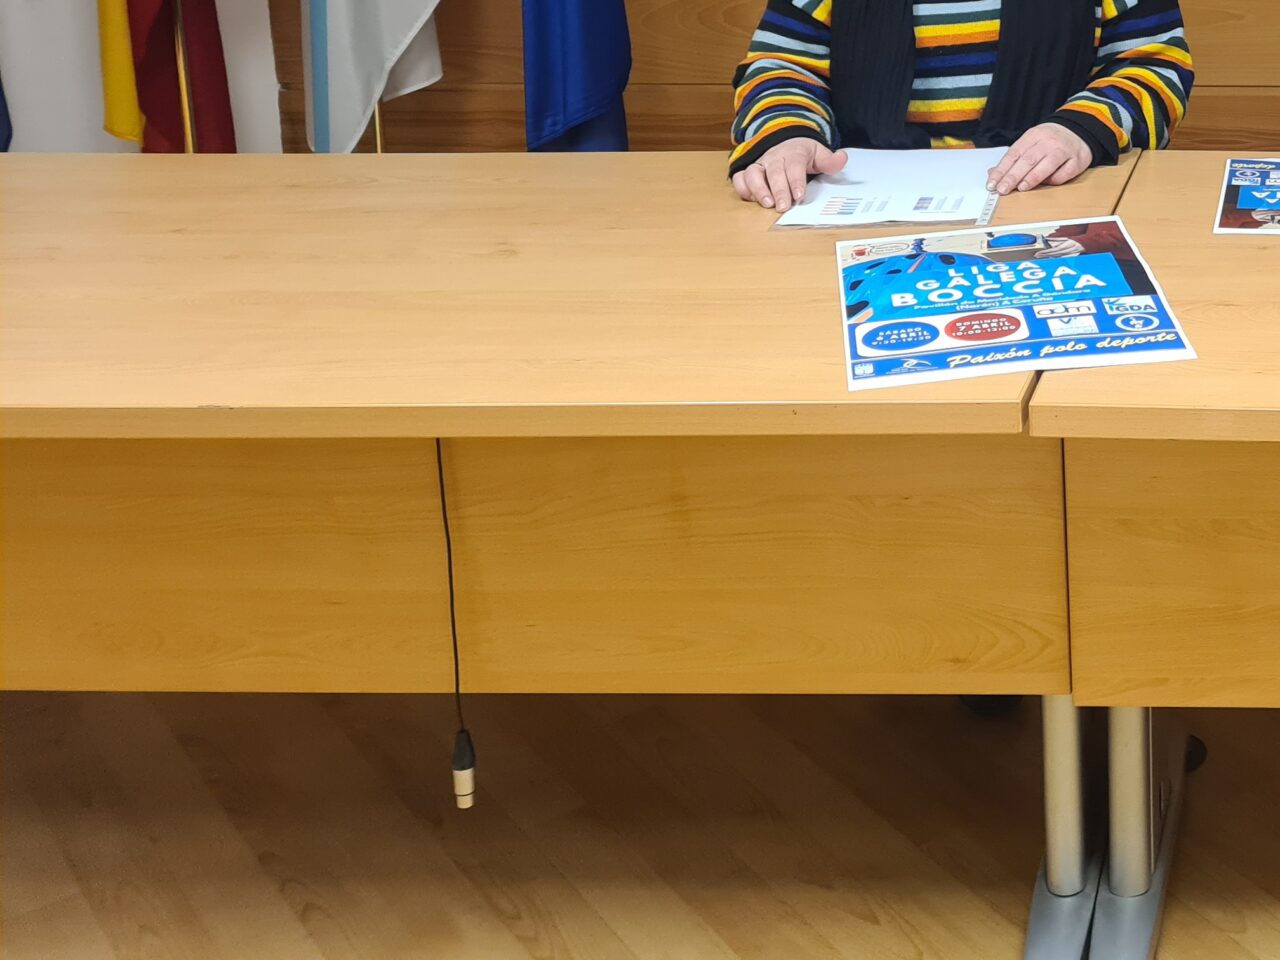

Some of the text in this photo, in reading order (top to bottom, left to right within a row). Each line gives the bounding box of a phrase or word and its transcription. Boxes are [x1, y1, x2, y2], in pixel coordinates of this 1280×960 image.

[948, 261, 1041, 277] LIGA
[915, 265, 1077, 291] GALEGA
[890, 274, 1107, 307] BOCCIA
[955, 317, 1008, 327] DOMINGO
[971, 320, 1012, 330] ABRIL
[889, 330, 931, 340] ABRIL
[947, 332, 1177, 369] Paixón polo deporte
